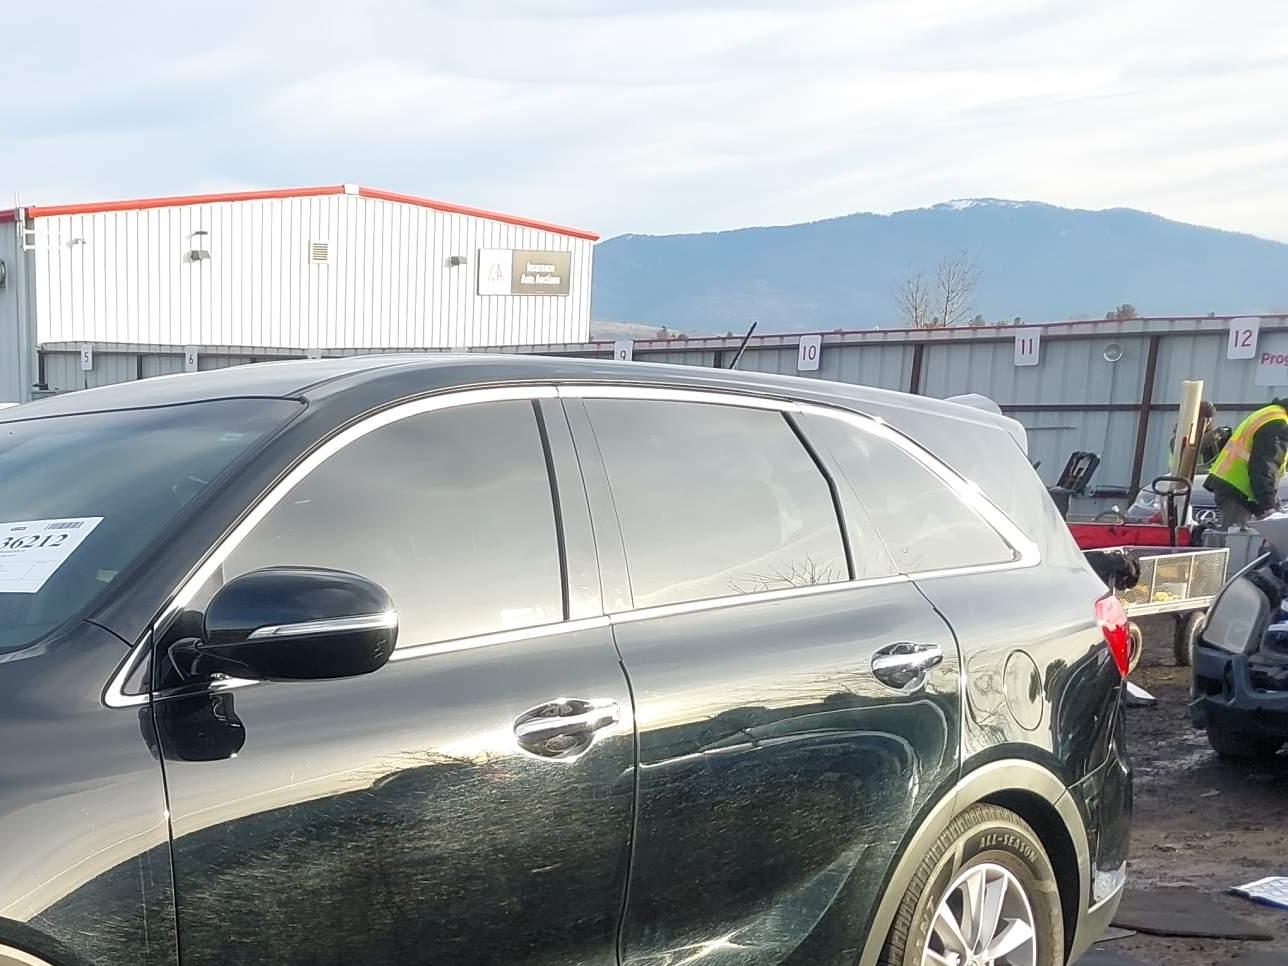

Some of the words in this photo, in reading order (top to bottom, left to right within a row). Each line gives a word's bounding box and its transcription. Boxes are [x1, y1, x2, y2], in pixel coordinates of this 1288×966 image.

[1020, 338, 1033, 355] 11
[1234, 329, 1253, 348] 12
[83, 353, 89, 363] 5
[188, 353, 194, 365] 6
[619, 350, 627, 361] 9
[802, 345, 816, 361] 10
[979, 833, 1038, 863] ALL-SEASON
